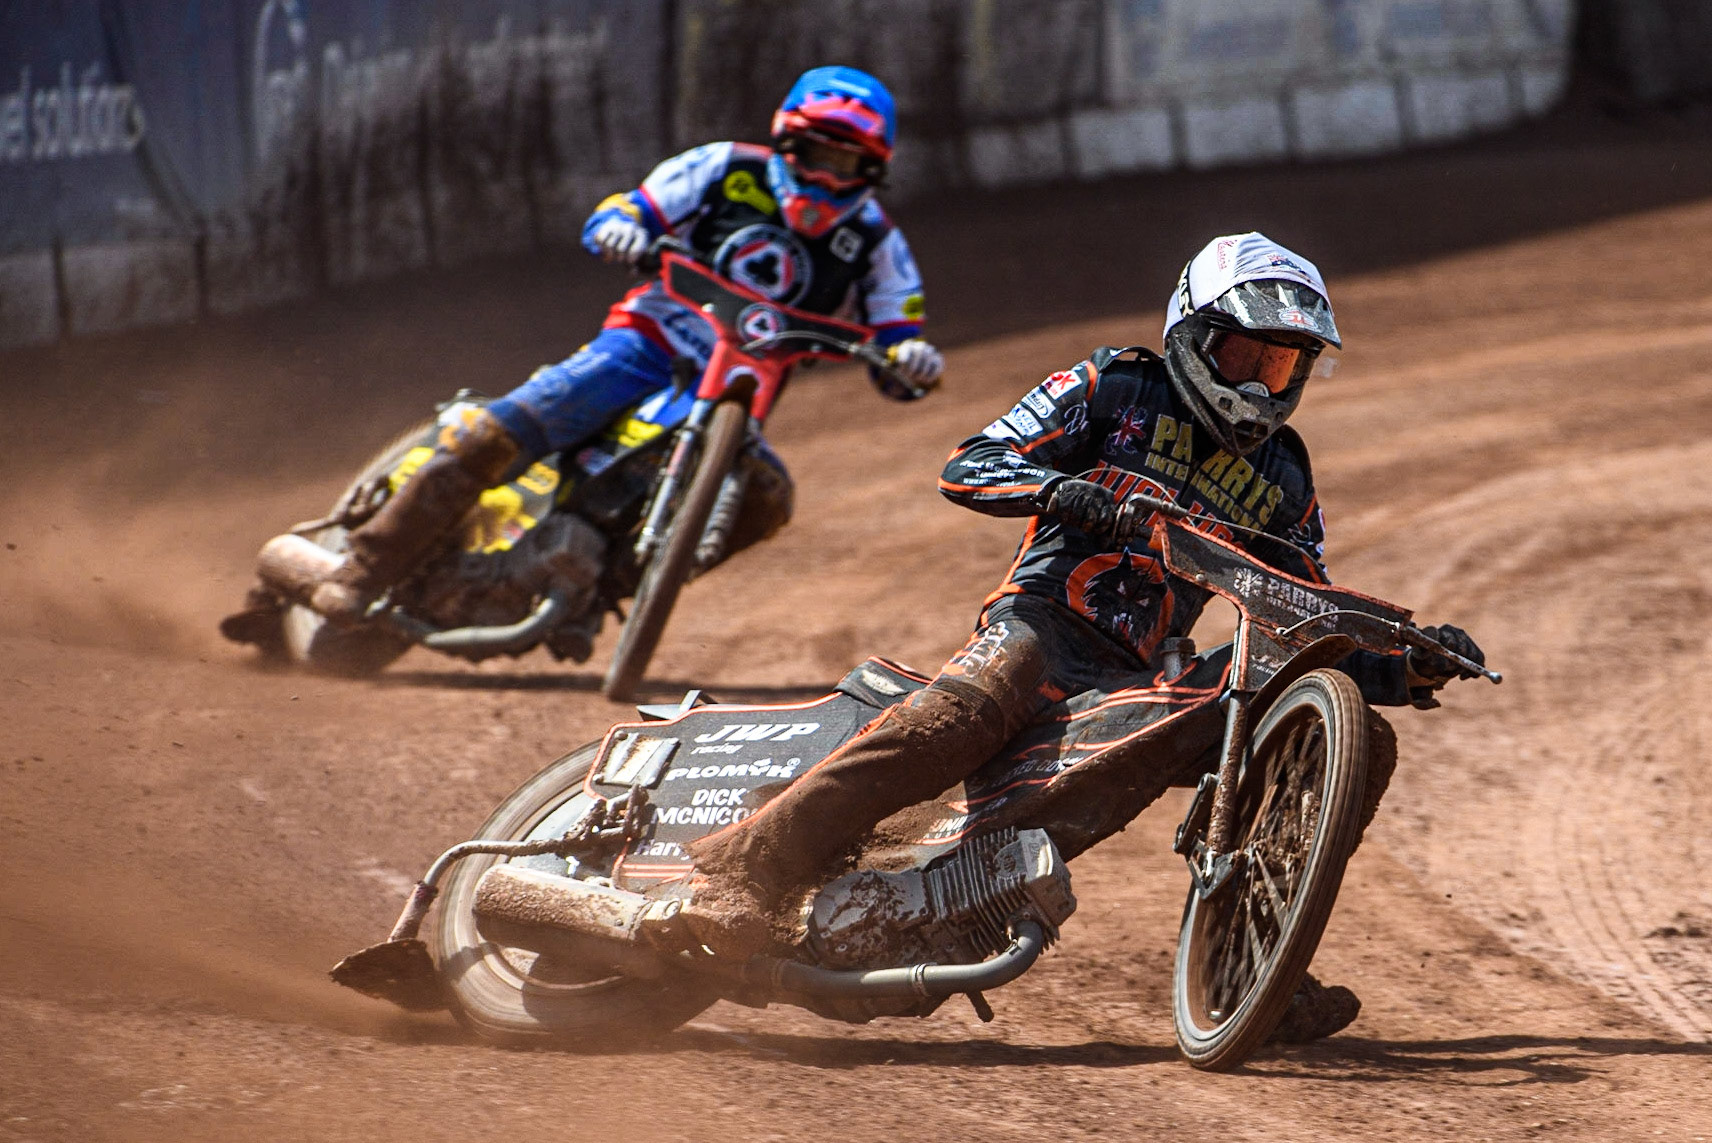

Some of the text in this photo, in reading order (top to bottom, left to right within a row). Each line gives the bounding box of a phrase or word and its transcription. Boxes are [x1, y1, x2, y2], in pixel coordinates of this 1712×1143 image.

[1151, 413, 1284, 527] PARRYS
[1267, 577, 1339, 622] PARRYS
[693, 722, 821, 743] JWP
[691, 743, 744, 755] racing
[691, 788, 749, 806] DICK
[650, 806, 757, 825] MCNICO
